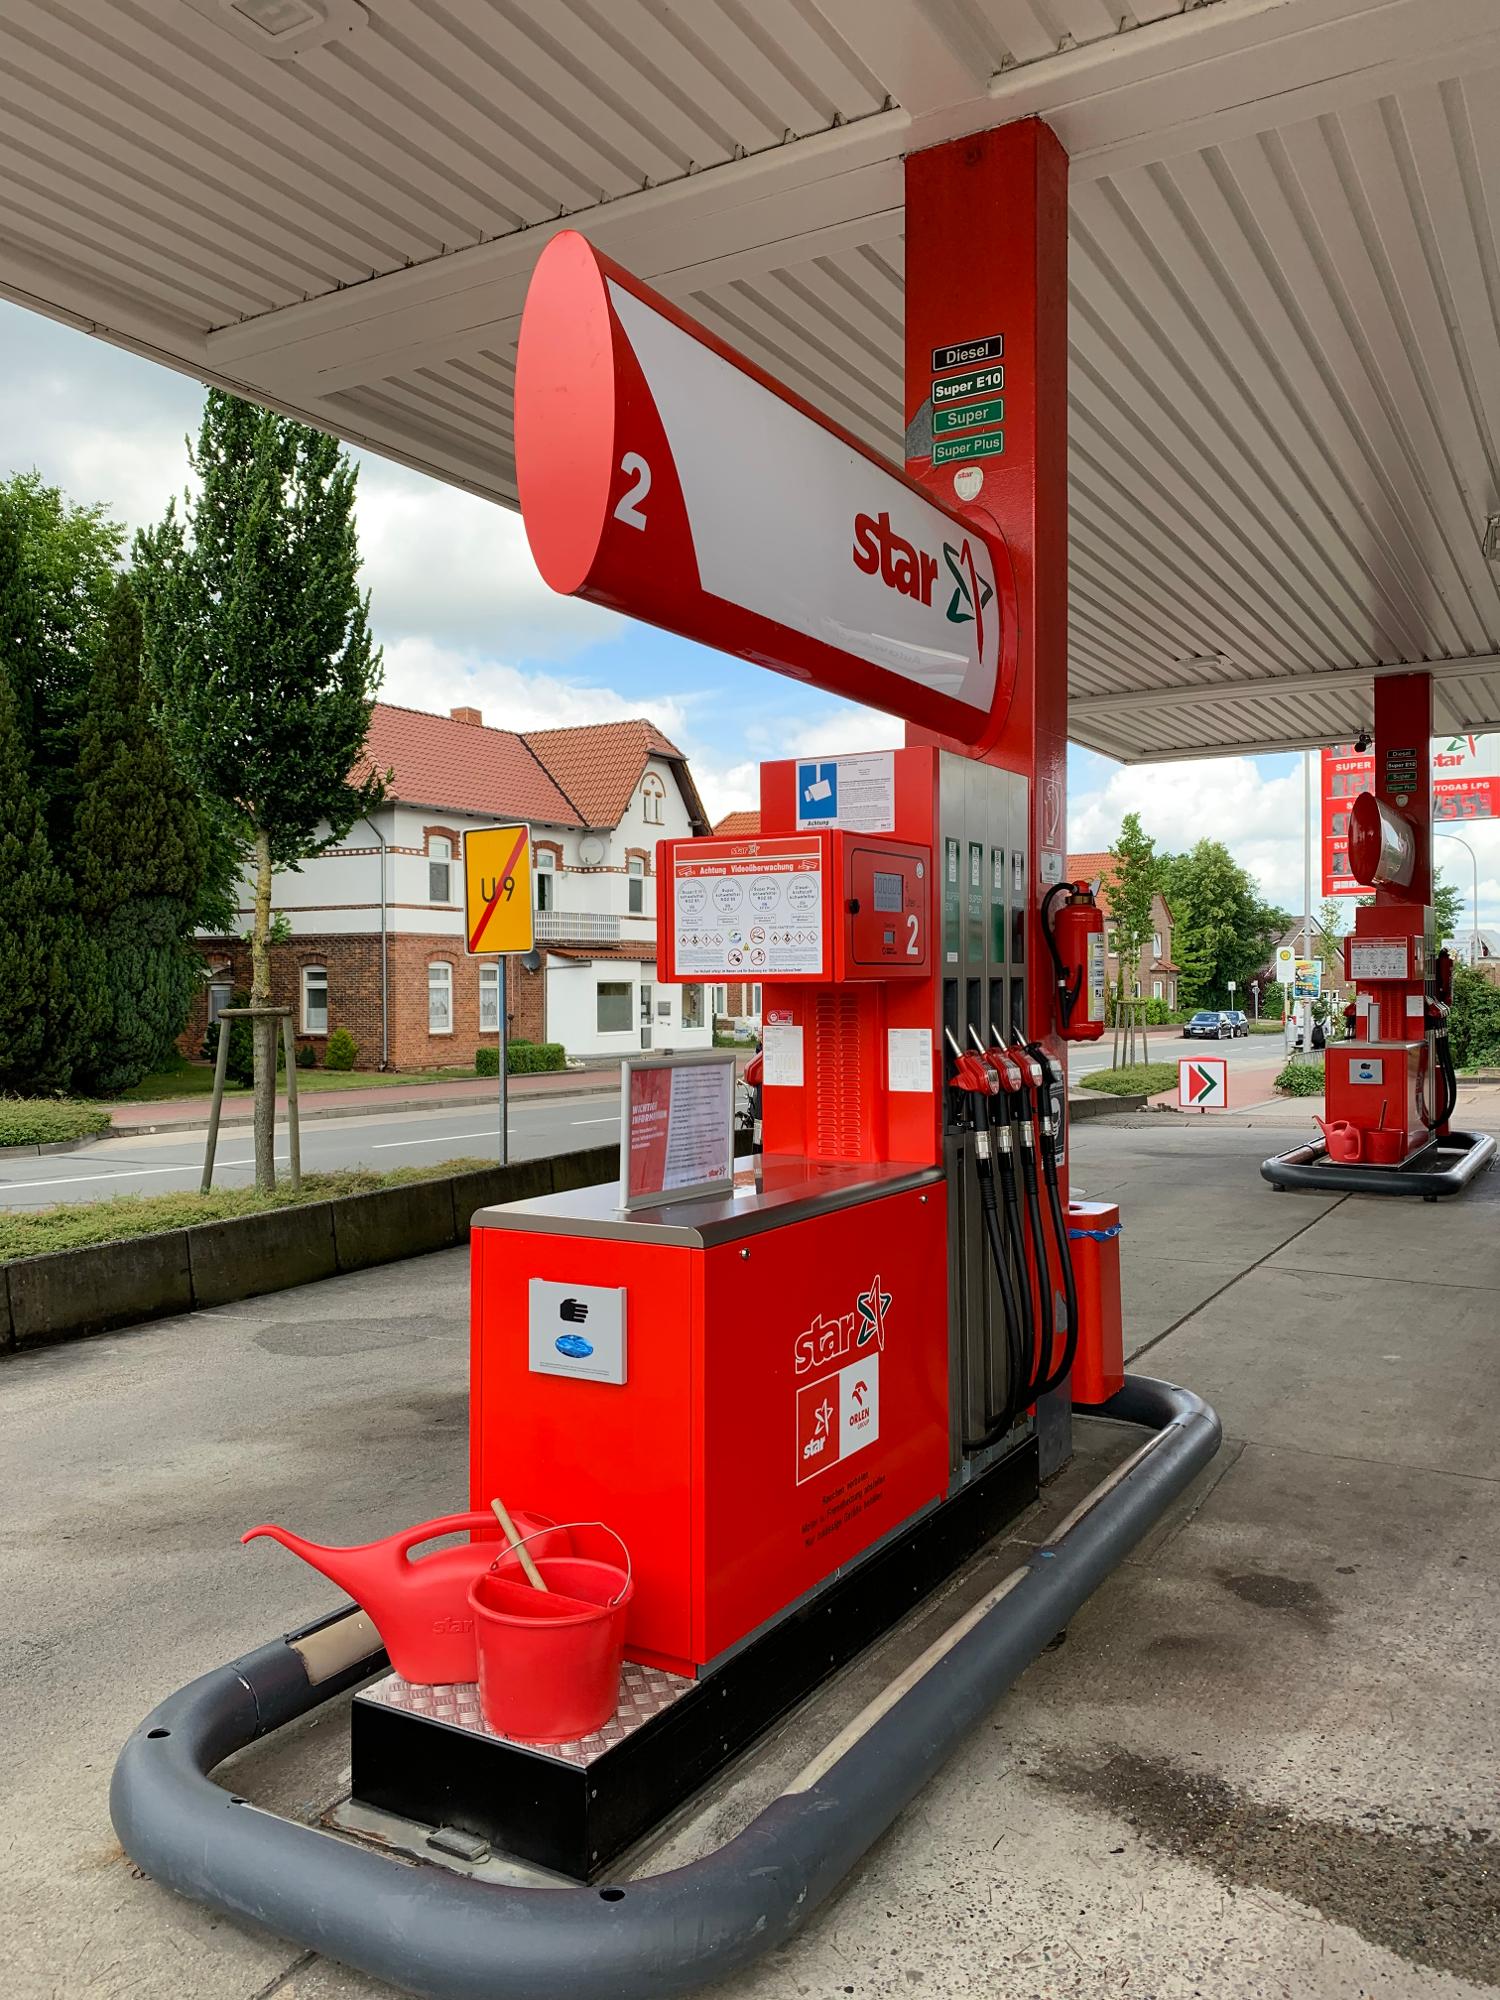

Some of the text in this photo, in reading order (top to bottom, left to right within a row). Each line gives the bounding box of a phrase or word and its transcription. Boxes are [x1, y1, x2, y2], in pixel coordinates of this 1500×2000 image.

[946, 343, 989, 364] Diesel
[936, 372, 1001, 397] Super E10
[947, 408, 989, 426] Super
[937, 438, 1000, 458] Super Plus
[613, 451, 652, 532] 2
[852, 511, 939, 607] star
[1335, 761, 1371, 772] SUPER
[1470, 781, 1490, 790] LPG
[700, 863, 794, 876] Achtung Videoüberwachung
[906, 914, 919, 955] 2
[795, 1312, 854, 1374] star
[849, 1407, 870, 1427] ORLEN
[803, 1434, 826, 1460] star
[433, 1617, 472, 1635] star
